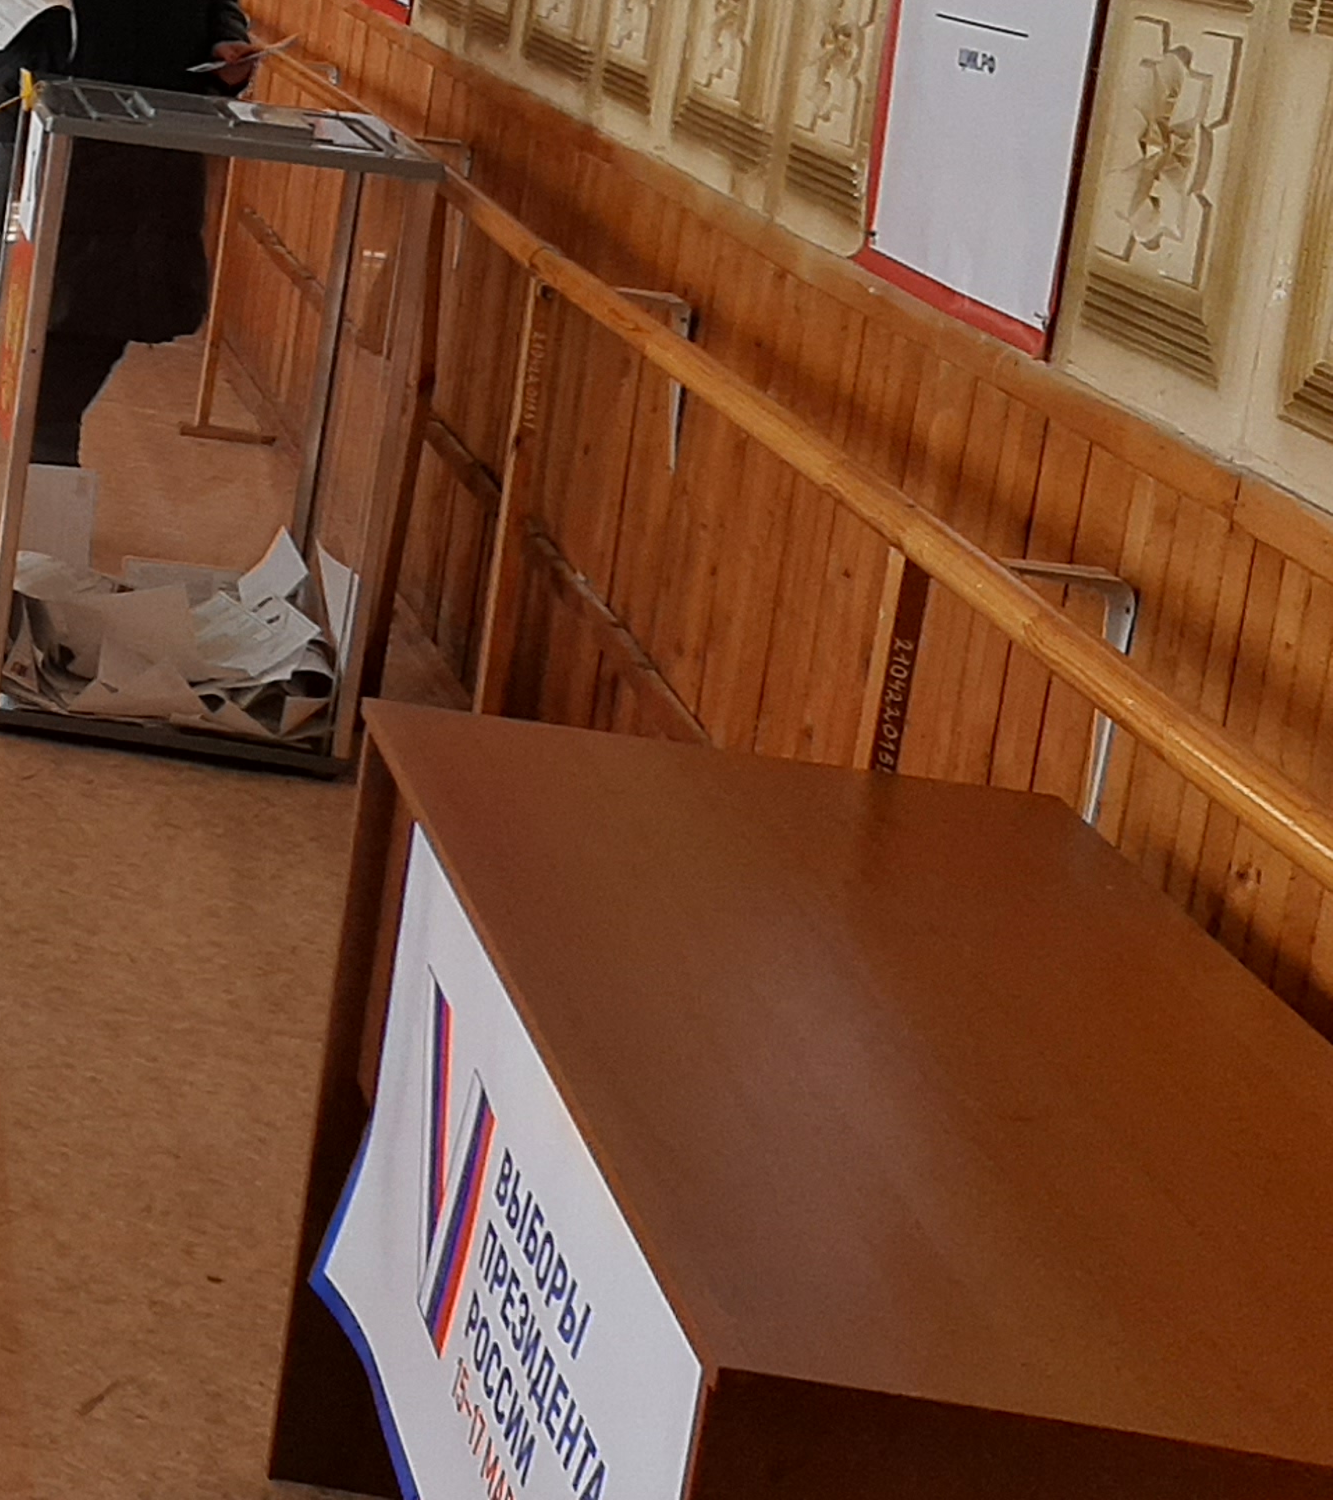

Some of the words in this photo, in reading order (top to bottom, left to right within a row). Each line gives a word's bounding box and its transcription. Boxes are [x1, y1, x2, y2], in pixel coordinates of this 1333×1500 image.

[478, 1220, 607, 1500] ПРЕЗИДЕНТА
[494, 1147, 593, 1360] ВЫБОРЫ
[464, 1289, 536, 1488] РОССИИ
